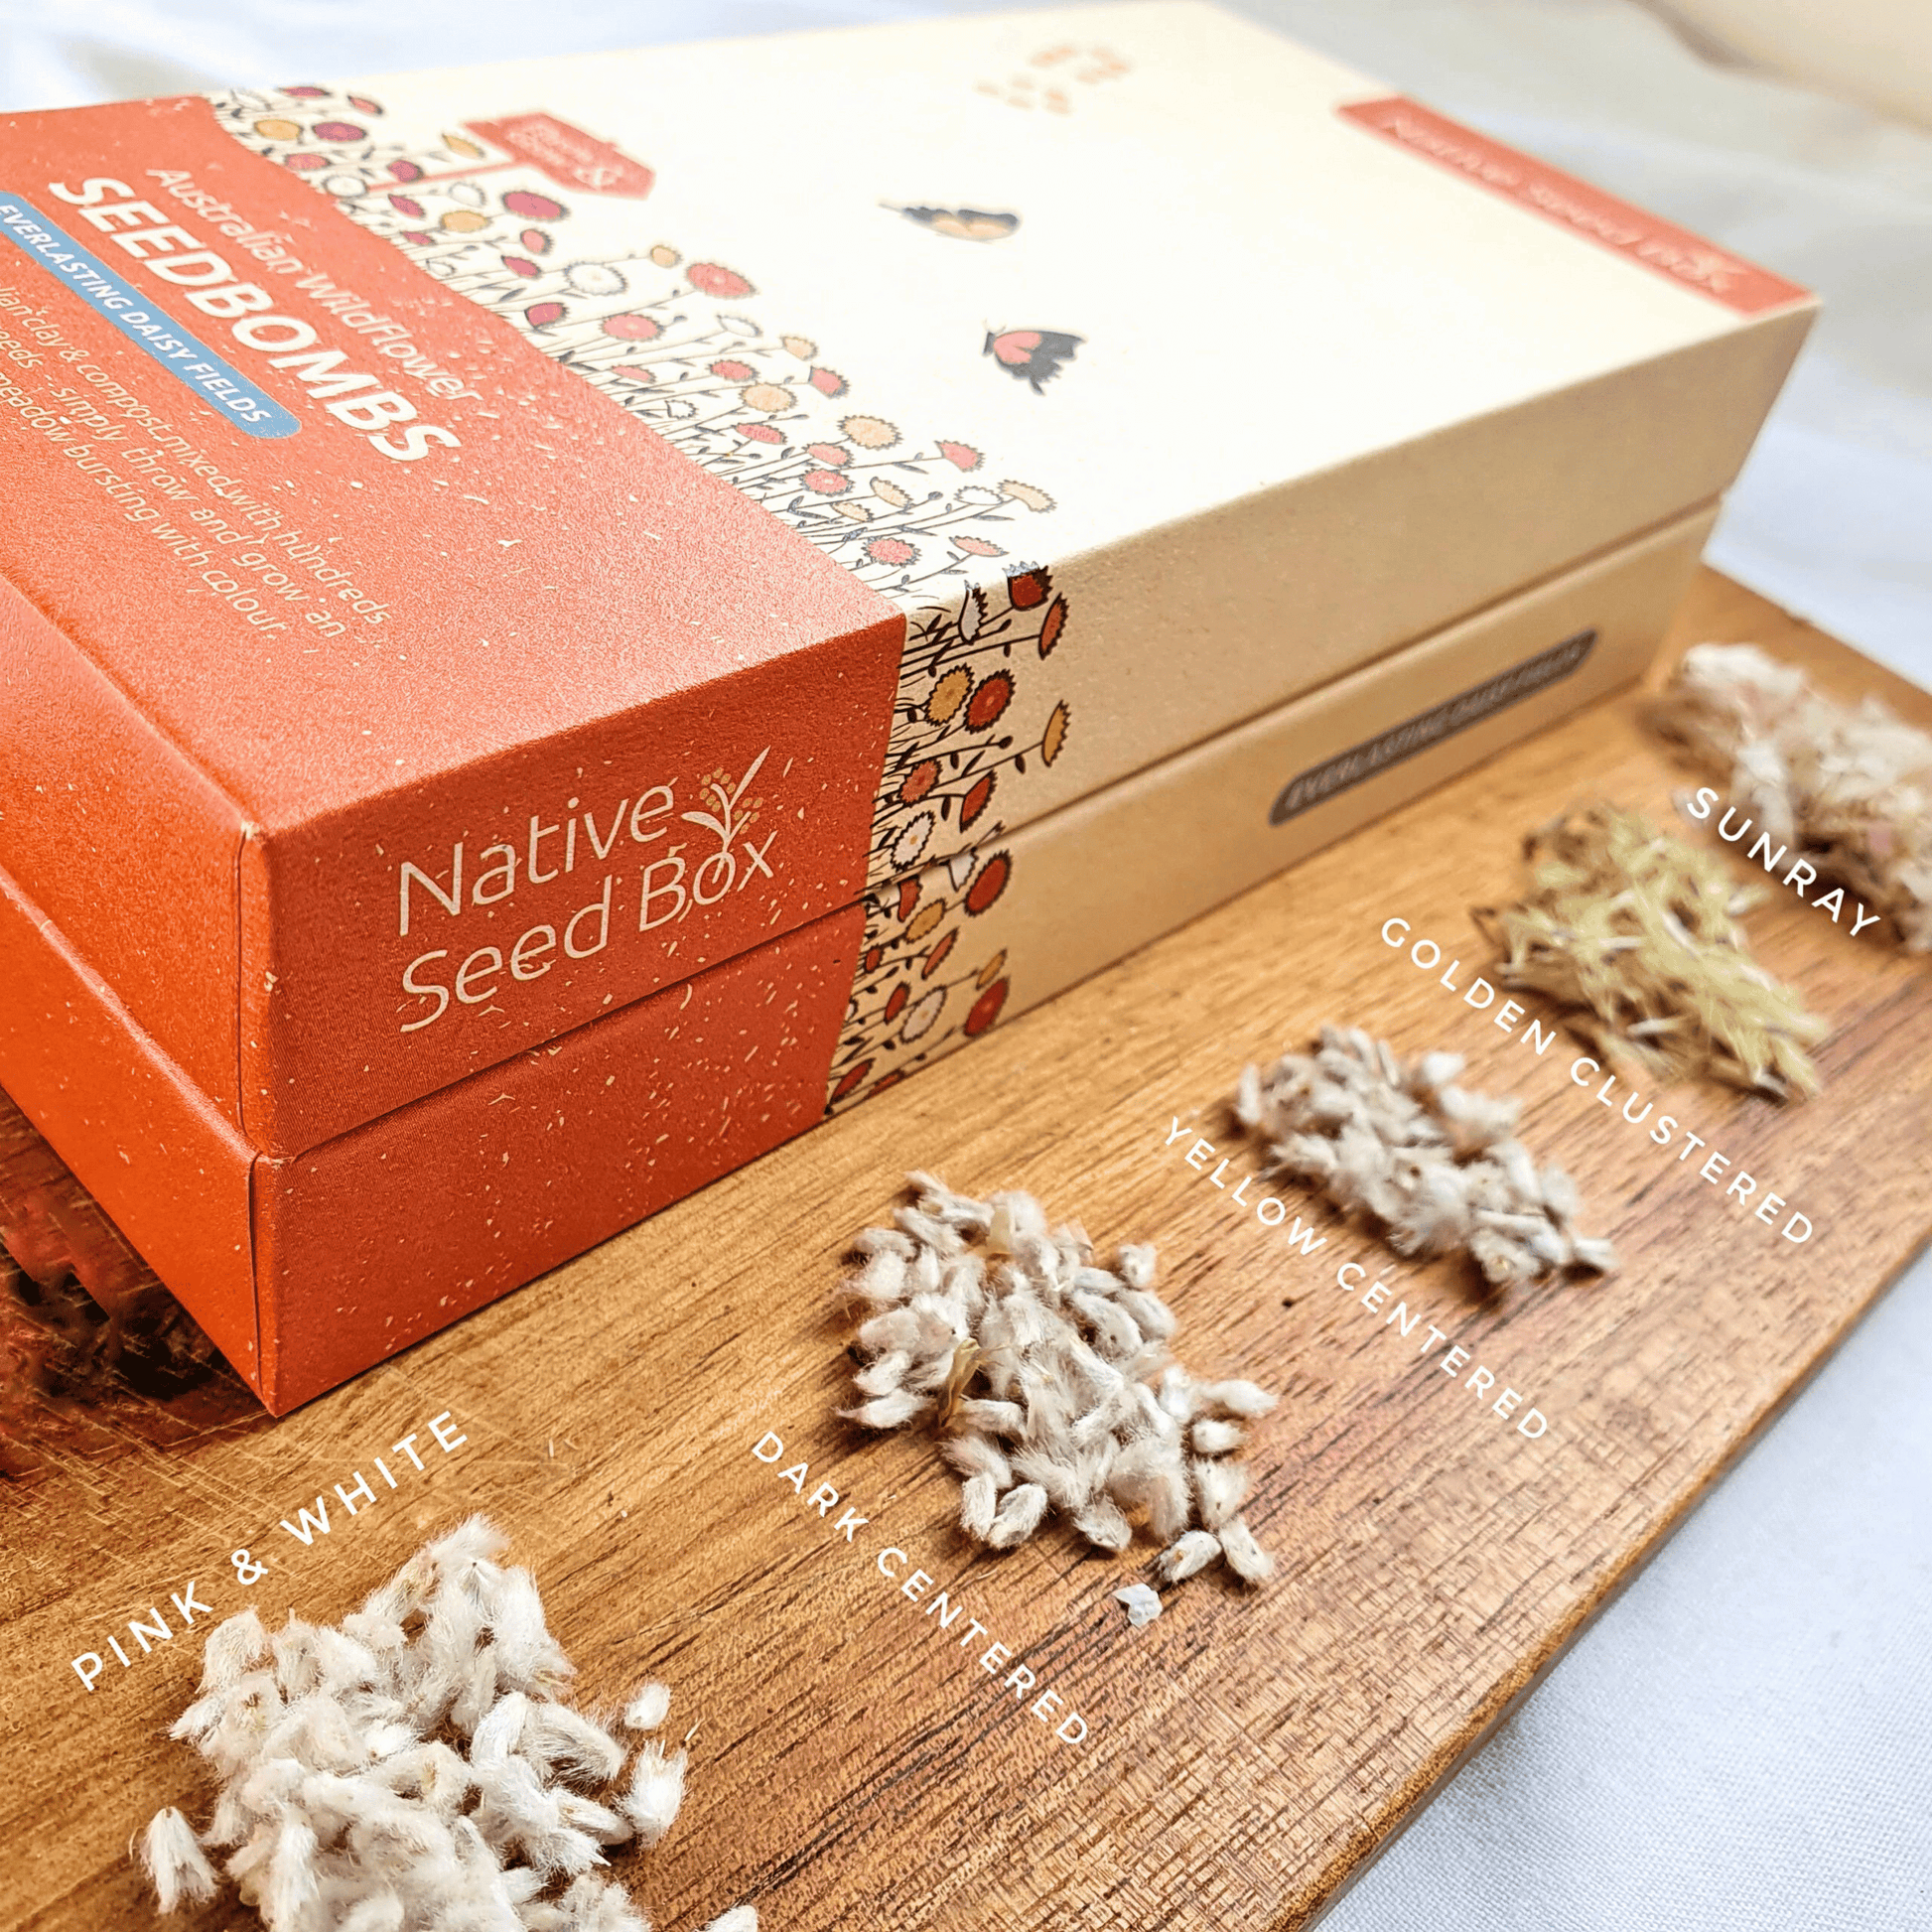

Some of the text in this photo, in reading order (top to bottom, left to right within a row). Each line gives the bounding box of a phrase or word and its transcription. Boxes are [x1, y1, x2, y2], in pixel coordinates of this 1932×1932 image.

[0, 205, 272, 423] EVERLASTING DAISY FIELDS
[49, 177, 461, 462] SEEDBOMBS
[146, 169, 483, 401] Australian Wildflower
[22, 318, 71, 346] clay
[60, 348, 90, 363] &
[76, 364, 173, 435] compost
[160, 435, 243, 488] mixed
[225, 488, 284, 532] with
[272, 529, 391, 624] hundreds
[50, 387, 129, 441] simply
[121, 447, 200, 500] throw
[190, 508, 253, 544] and
[231, 552, 310, 601] grow
[305, 610, 346, 638] an
[63, 444, 160, 522] bursting
[151, 522, 214, 567] with
[400, 785, 674, 937] Native
[400, 830, 777, 1033] Seed Box
